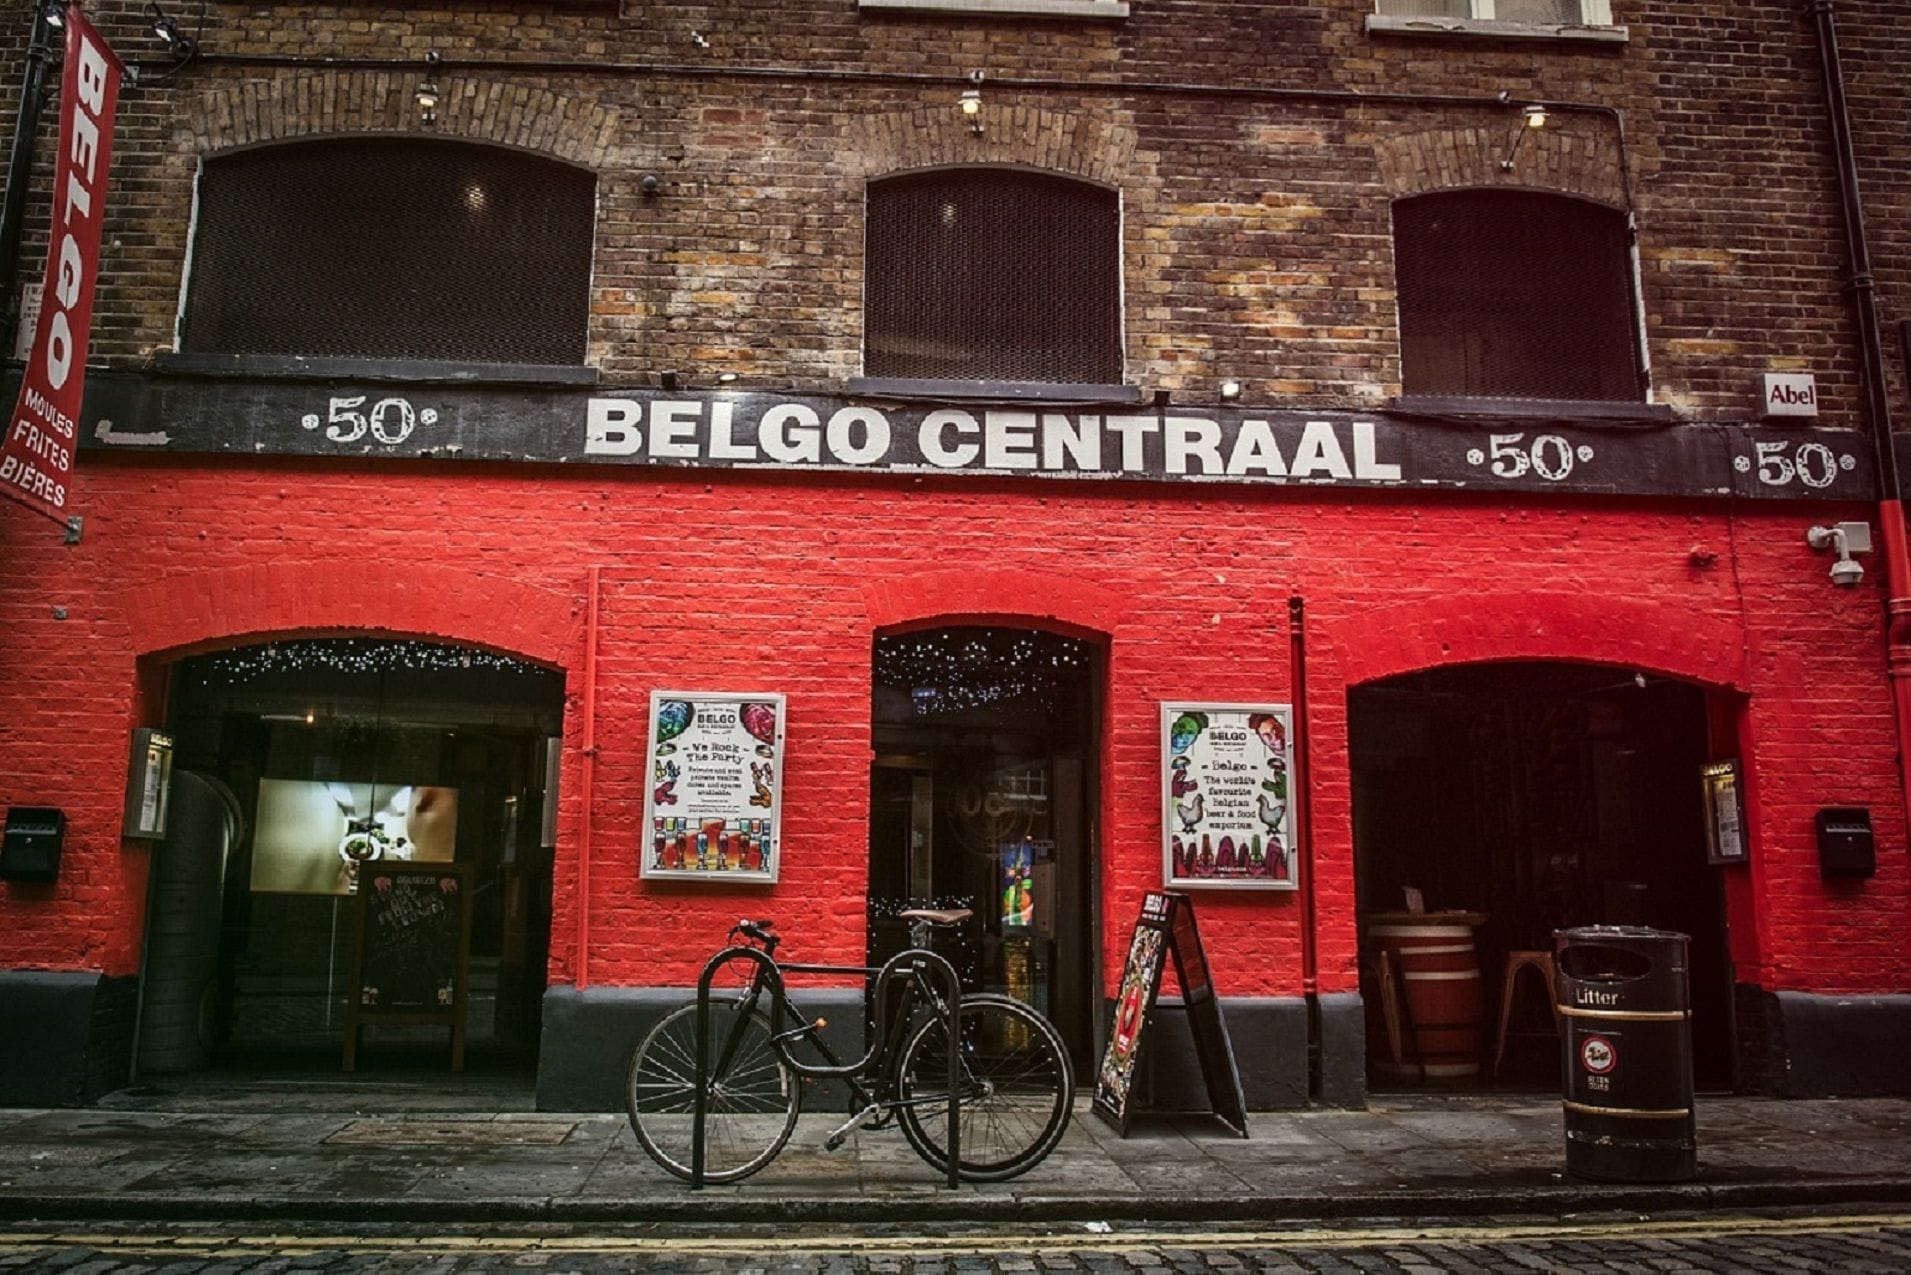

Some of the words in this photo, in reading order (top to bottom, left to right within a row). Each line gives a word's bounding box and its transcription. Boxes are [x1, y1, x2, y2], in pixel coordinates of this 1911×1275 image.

[47, 34, 108, 390] BELGO
[1770, 384, 1814, 405] Abel
[25, 388, 73, 439] MOULES
[326, 395, 416, 444] 50
[13, 419, 69, 472] FRITES
[584, 398, 891, 464] BELGO
[918, 408, 1401, 481] CENTRAAL
[1490, 432, 1573, 480] 50
[1756, 441, 1837, 488] 50
[698, 714, 736, 724] BELGO
[1210, 732, 1247, 741] BELGO
[711, 752, 744, 765] Party
[1212, 759, 1248, 773] Belgo
[1203, 775, 1221, 785] The
[1208, 787, 1252, 796] favourite
[1212, 797, 1250, 808] Belgian
[1205, 808, 1226, 818] beer
[1227, 810, 1235, 818] &
[1237, 809, 1257, 819] food
[1208, 821, 1254, 831] emporium
[1576, 988, 1619, 1005] Litter
